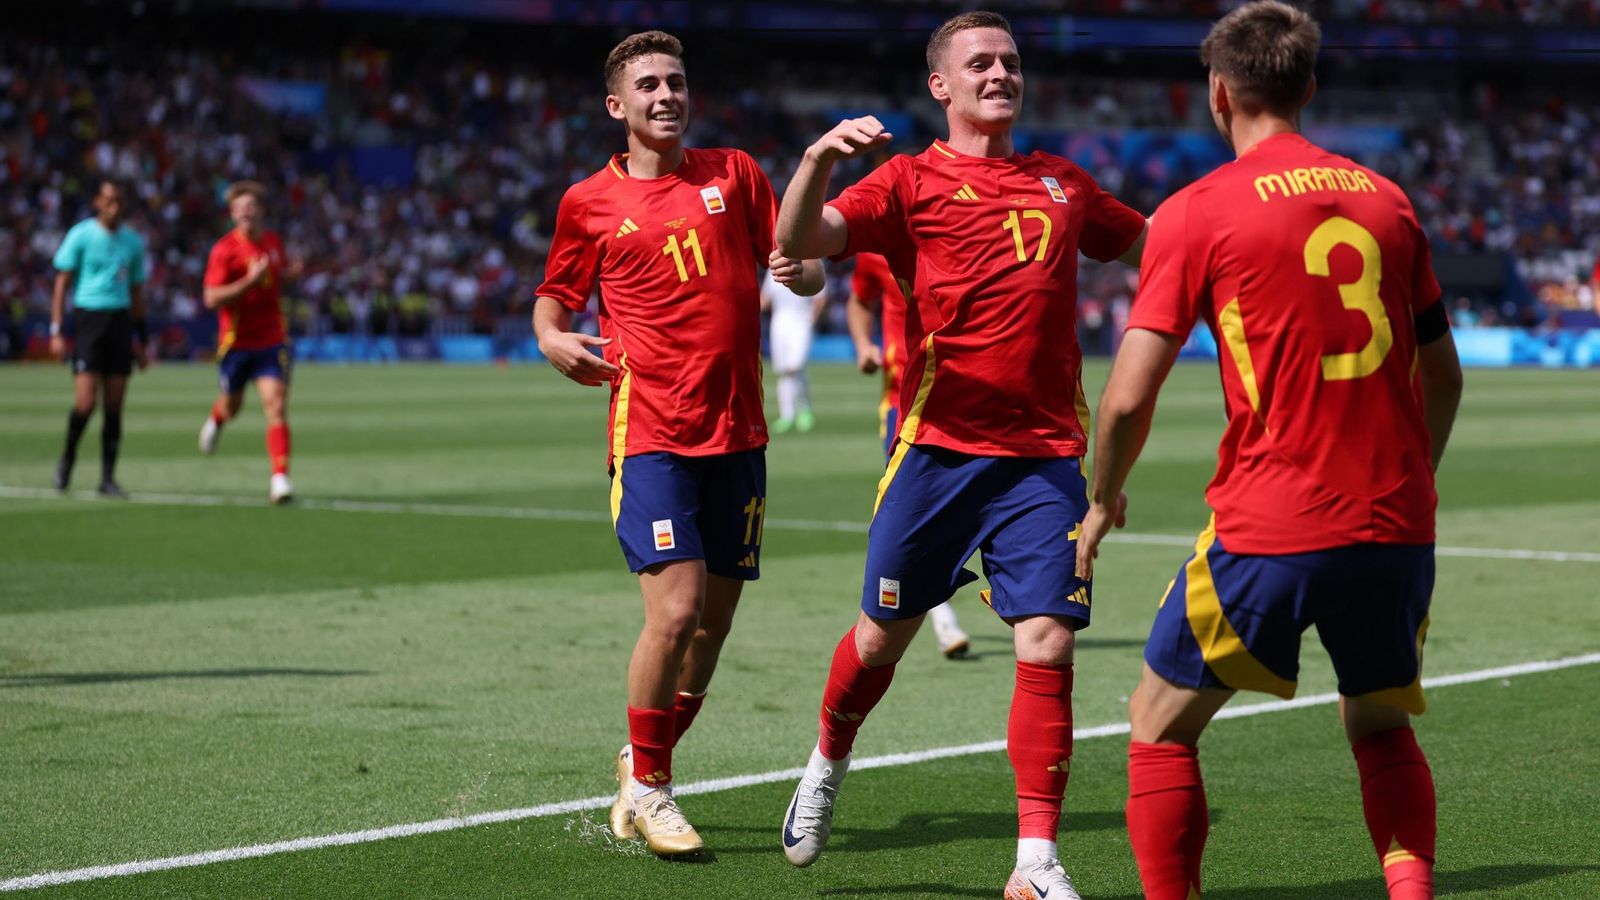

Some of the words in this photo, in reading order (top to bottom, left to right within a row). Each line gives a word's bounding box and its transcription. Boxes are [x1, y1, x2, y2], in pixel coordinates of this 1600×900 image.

[1254, 167, 1377, 202] MIRANDA
[662, 228, 708, 283] 11
[1002, 209, 1053, 262] 17
[1303, 215, 1394, 382] 3
[743, 496, 767, 546] 11
